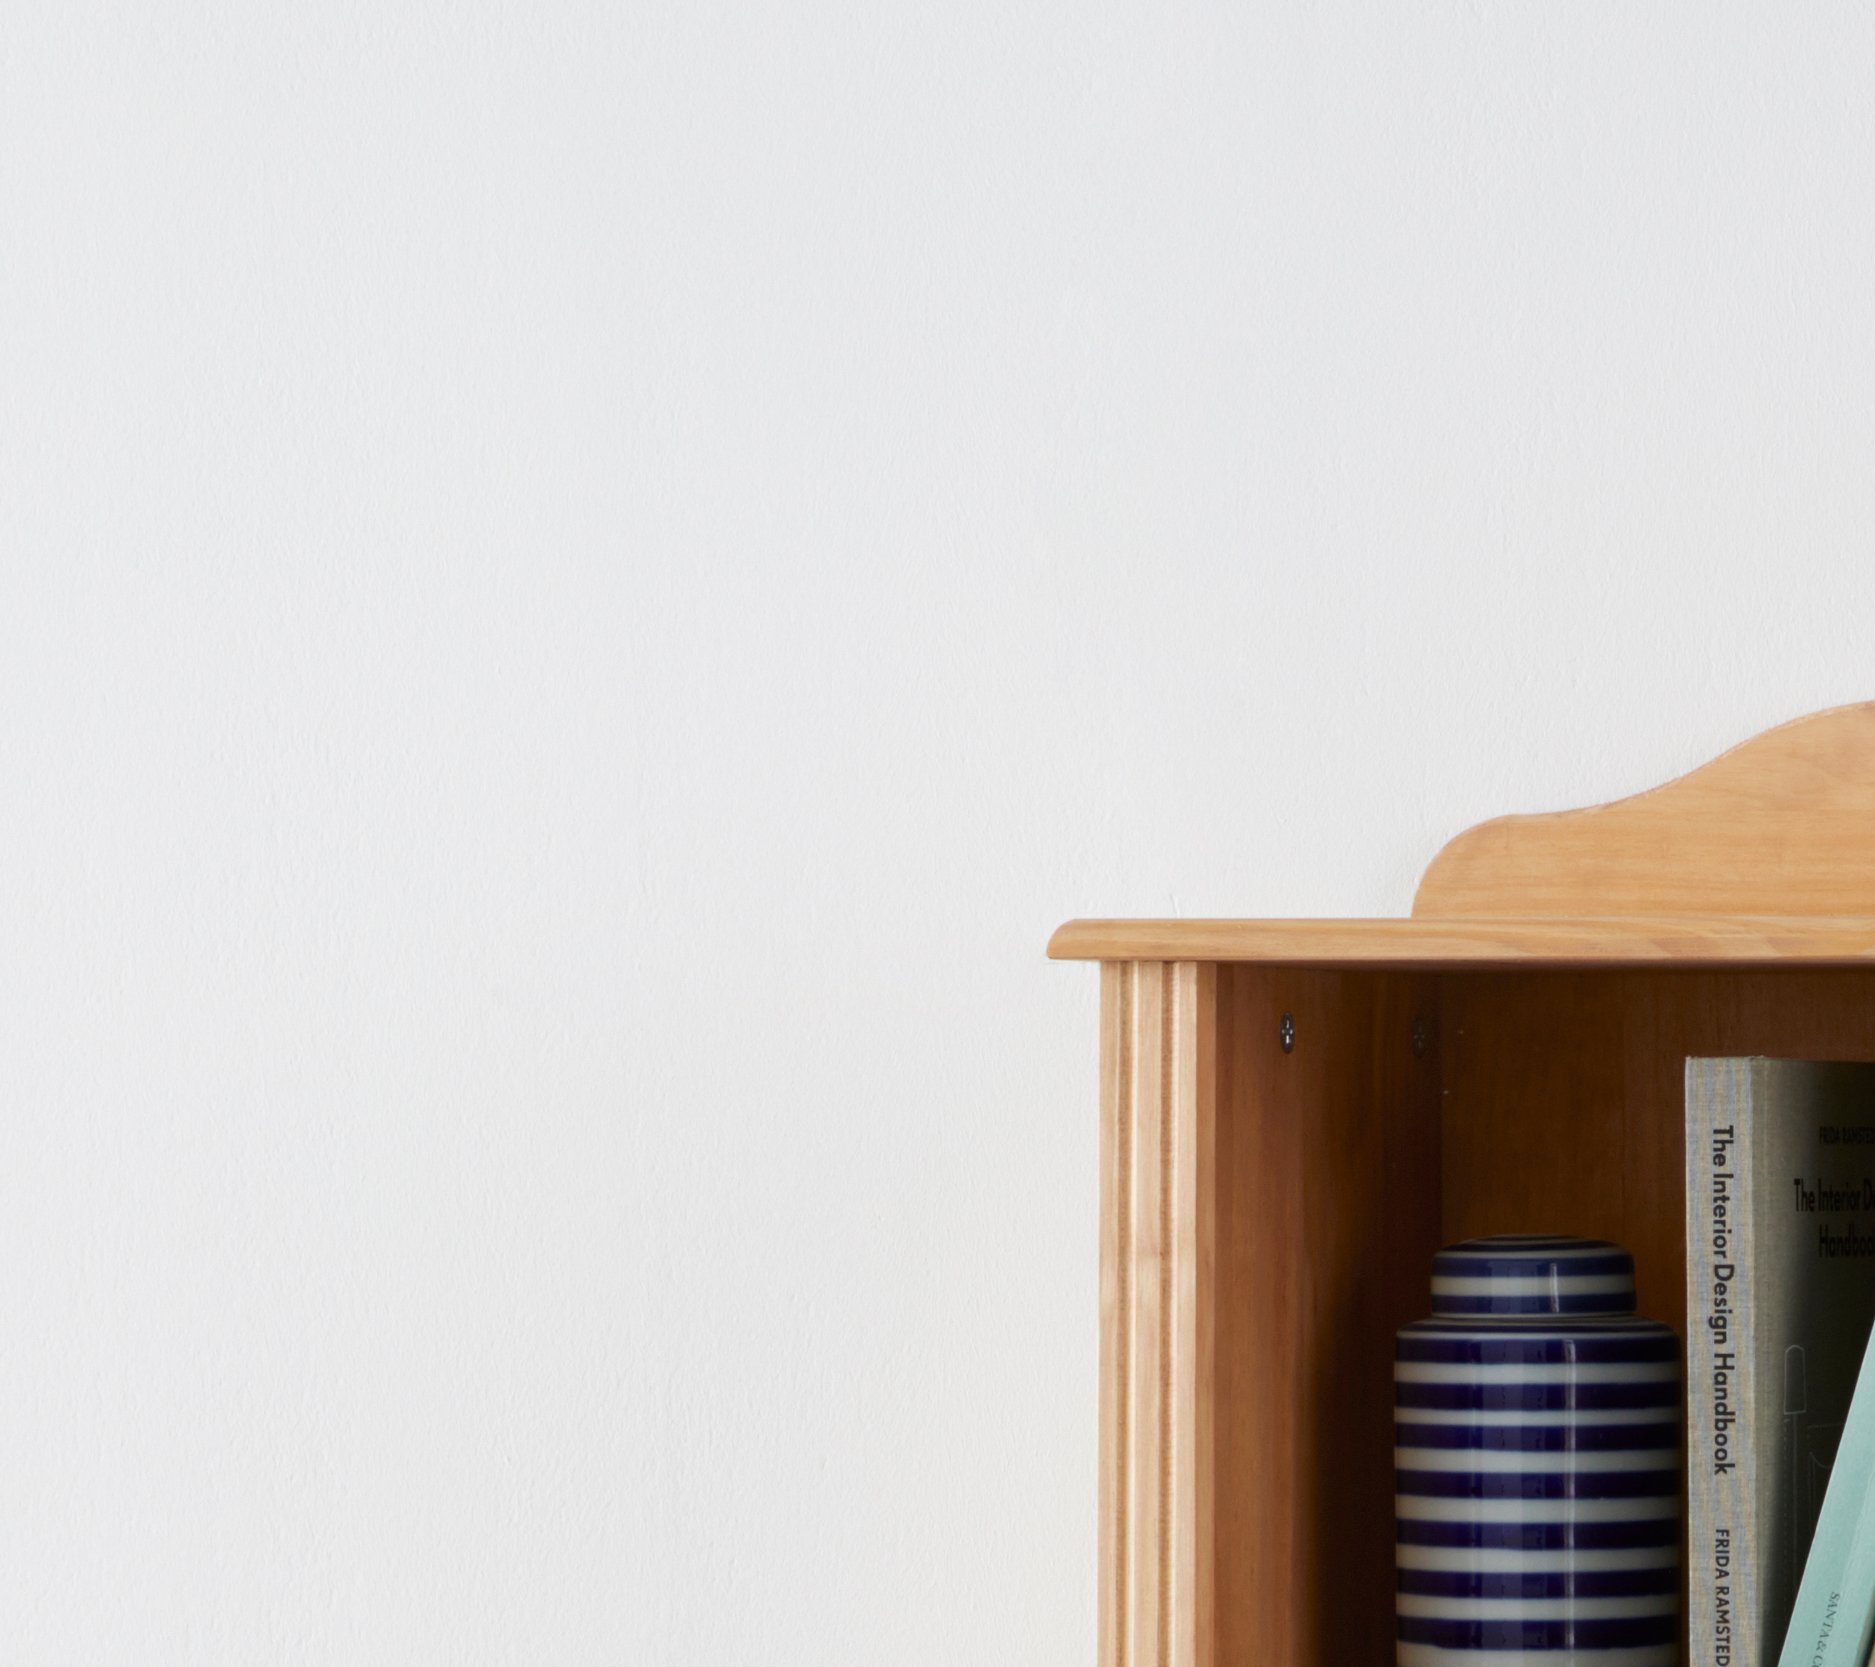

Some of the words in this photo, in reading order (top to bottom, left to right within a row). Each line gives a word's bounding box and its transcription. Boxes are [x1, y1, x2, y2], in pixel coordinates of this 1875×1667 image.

[1713, 1125, 1734, 1167] The
[1713, 1173, 1734, 1258] Interior
[1794, 1178, 1815, 1213] The
[1817, 1178, 1862, 1213] Interior
[1708, 1264, 1735, 1345] Design
[1713, 1353, 1736, 1475] Handbook
[1715, 1529, 1730, 1579] FRIDA
[1819, 1591, 1840, 1638] SANTA
[1816, 1640, 1827, 1652] &
